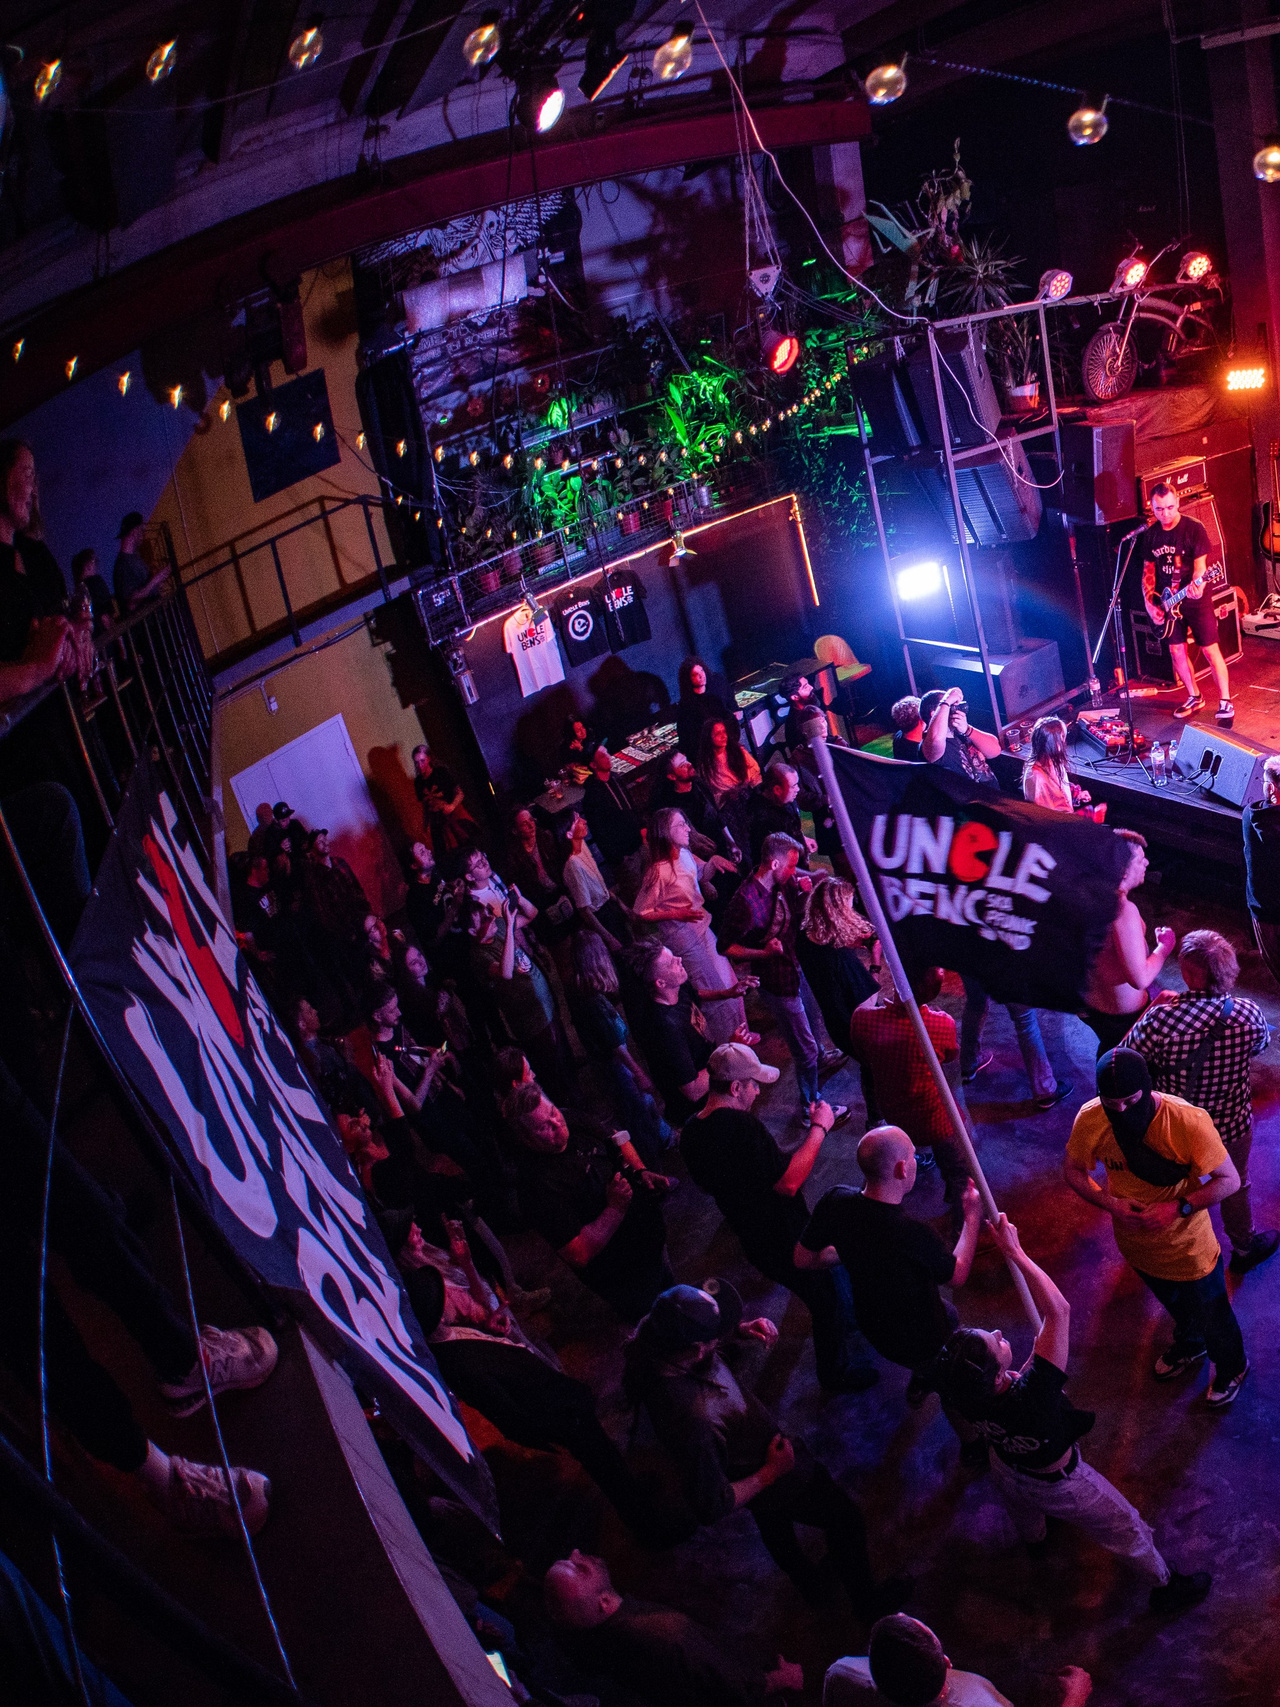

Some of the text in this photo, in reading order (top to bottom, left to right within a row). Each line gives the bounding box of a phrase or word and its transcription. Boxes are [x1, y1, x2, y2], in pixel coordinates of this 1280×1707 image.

[517, 625, 545, 642] UNCLE
[521, 635, 541, 651] BENS
[868, 813, 1058, 904] UNCLE
